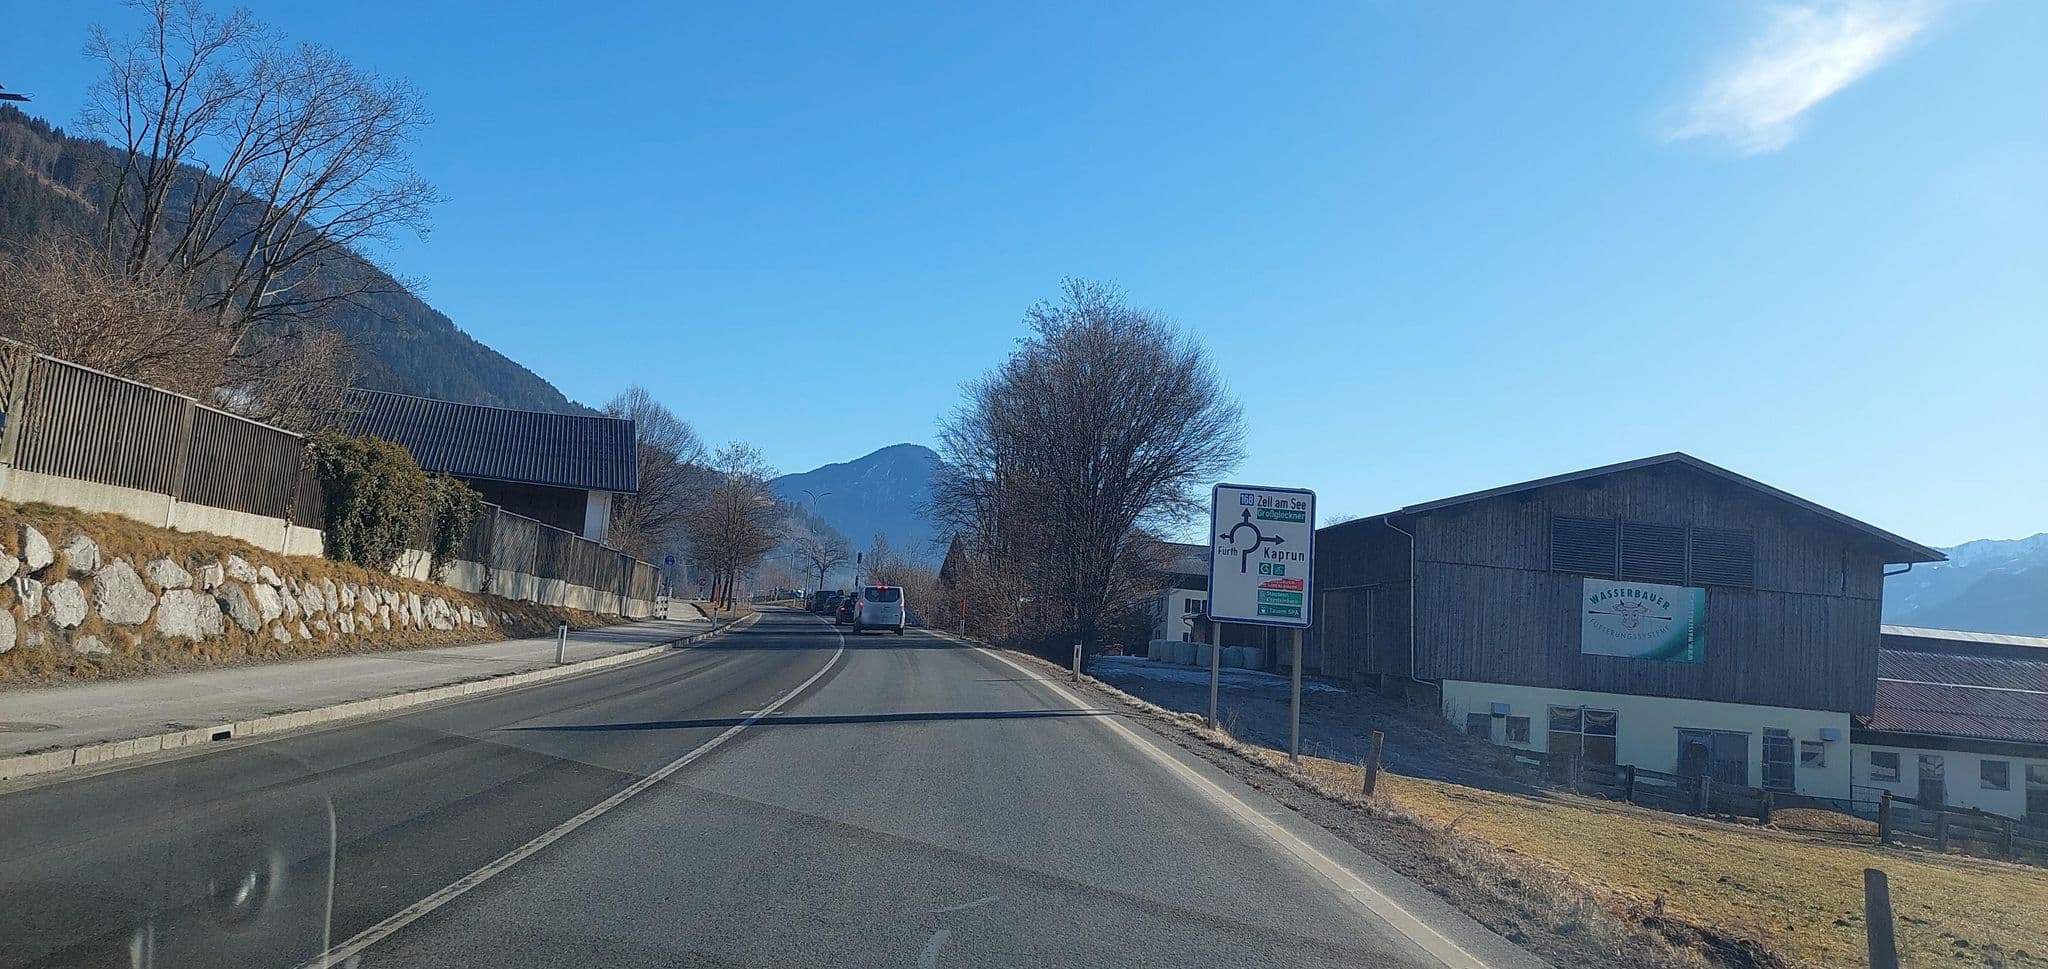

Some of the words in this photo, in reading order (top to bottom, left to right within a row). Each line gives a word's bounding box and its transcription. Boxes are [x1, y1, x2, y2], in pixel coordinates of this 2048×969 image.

[1240, 494, 1254, 505] 168
[1257, 495, 1273, 508] Zell
[1275, 498, 1288, 509] am
[1290, 498, 1306, 510] See
[1257, 509, 1305, 520] Großglockner
[1264, 547, 1305, 562] Kaprun
[1589, 588, 1671, 610] WASSERBAUER
